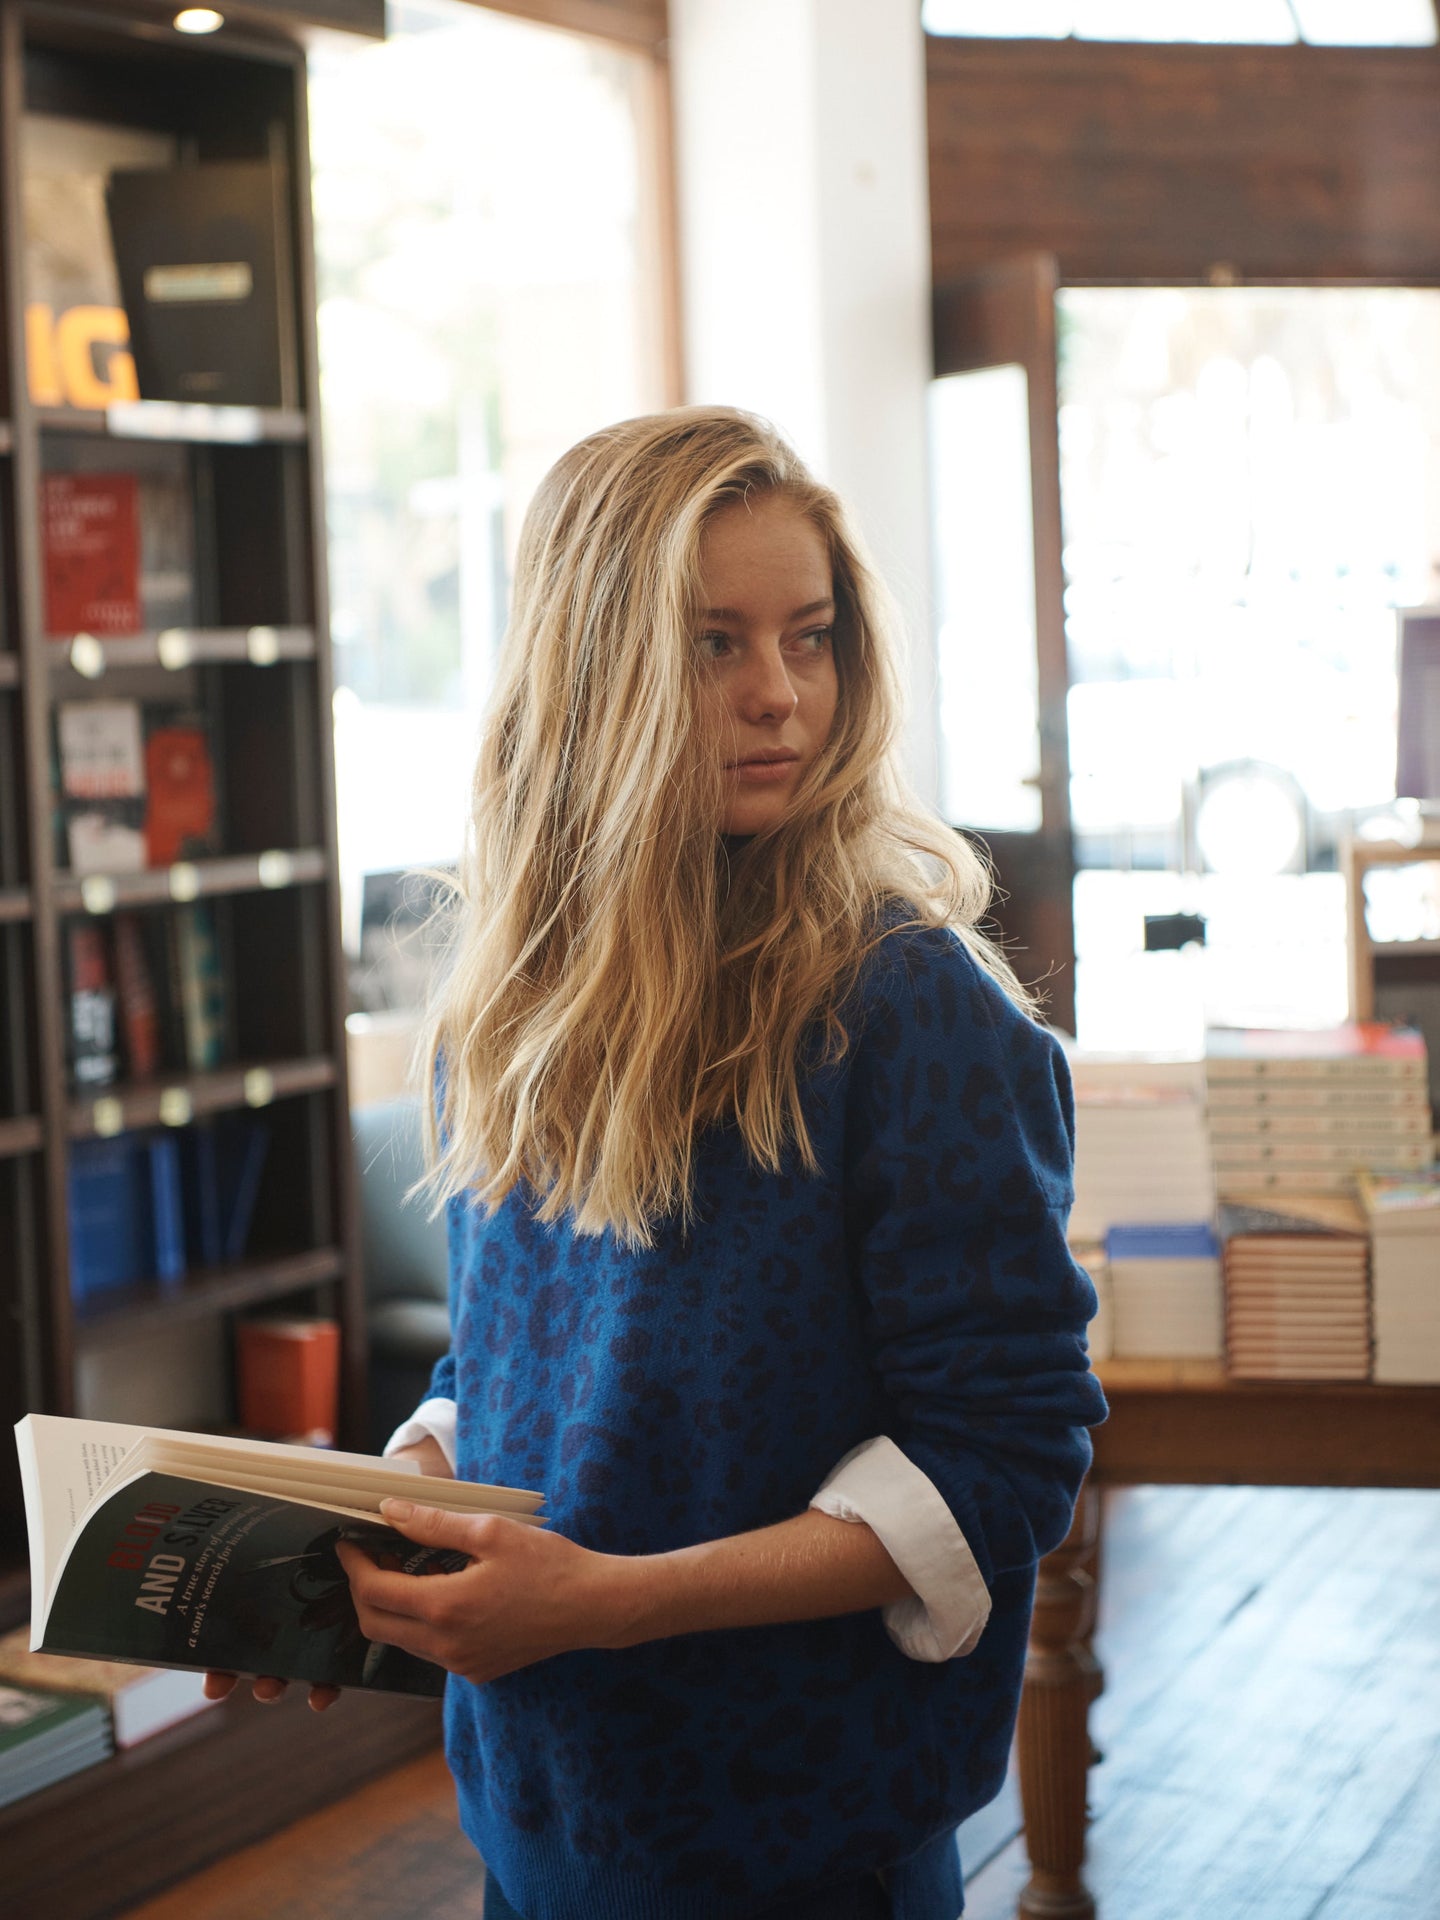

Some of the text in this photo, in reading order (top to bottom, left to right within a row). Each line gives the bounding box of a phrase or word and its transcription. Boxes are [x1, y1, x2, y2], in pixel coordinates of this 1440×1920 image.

[107, 1503, 182, 1570] BLOOD
[210, 1534, 223, 1546] of
[226, 1533, 243, 1547] his
[135, 1498, 242, 1616] AND SILVER
[194, 1545, 216, 1573] story
[217, 1545, 233, 1564] for
[181, 1573, 200, 1601] true
[202, 1562, 224, 1601] search
[176, 1603, 189, 1616] A
[191, 1602, 208, 1636] son's
[188, 1637, 198, 1648] a
